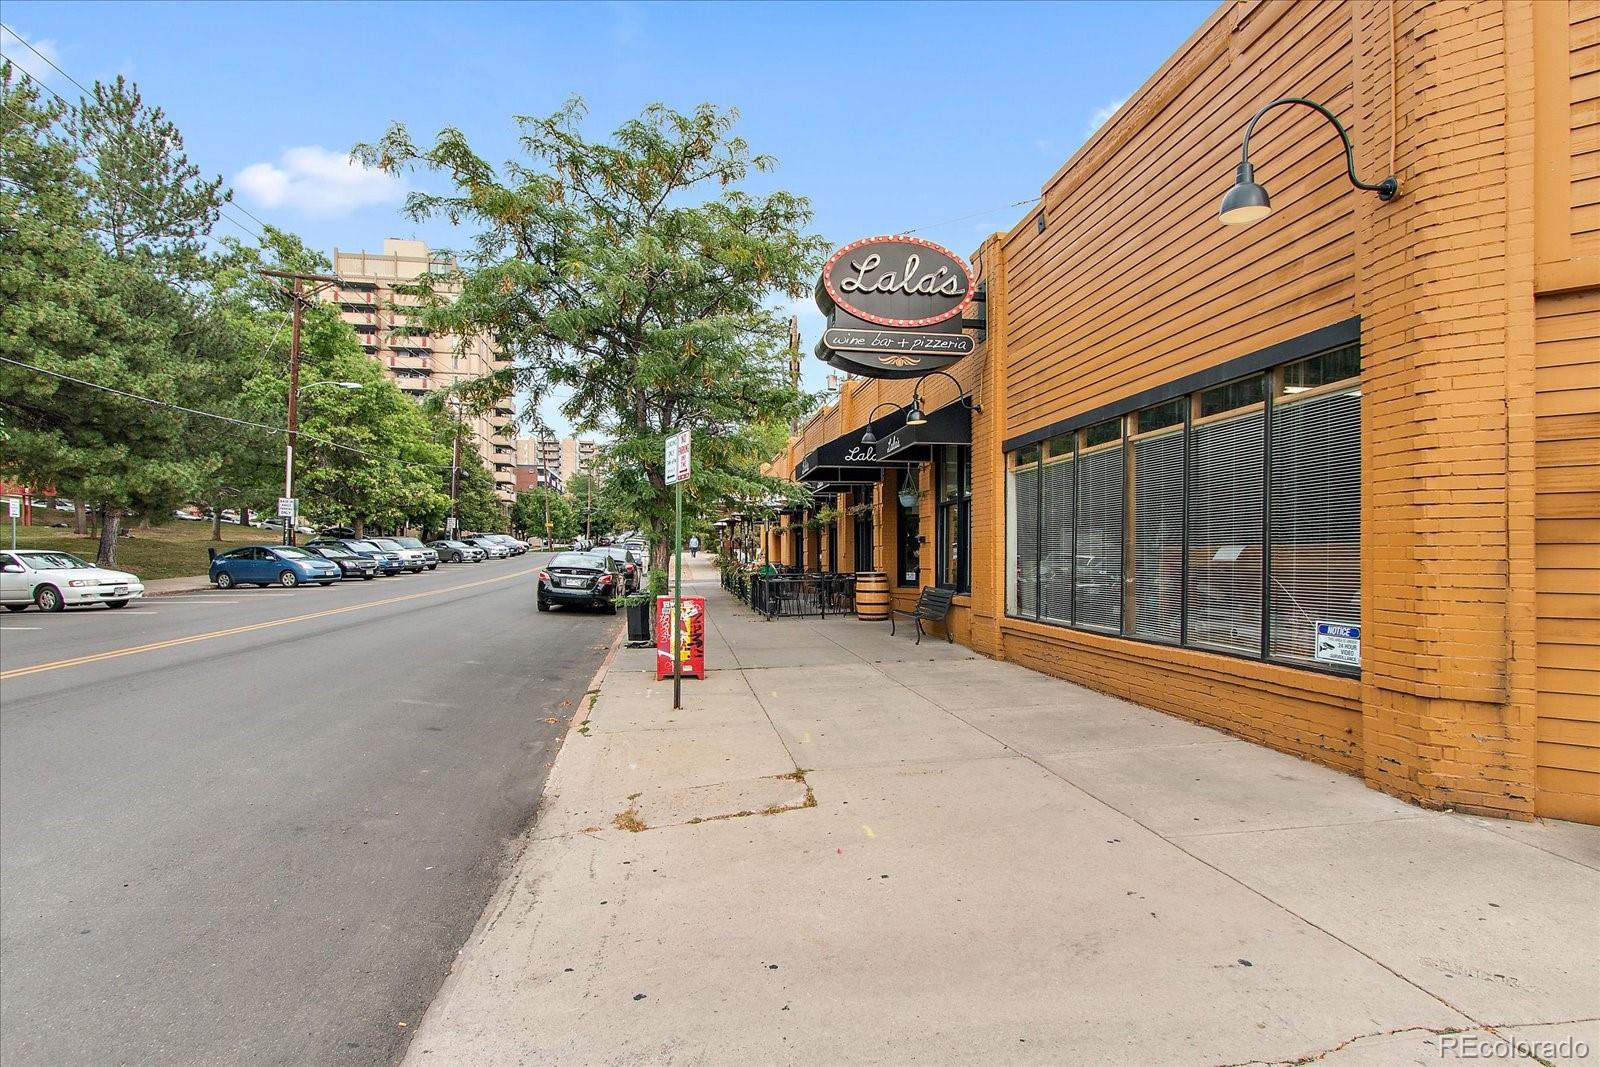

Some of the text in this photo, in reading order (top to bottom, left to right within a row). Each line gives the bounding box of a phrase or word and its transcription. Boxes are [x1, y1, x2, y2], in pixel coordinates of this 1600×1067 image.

[840, 253, 966, 296] Lala's
[832, 332, 968, 351] wine bar + pizzeria
[1327, 625, 1351, 637] NOTICE
